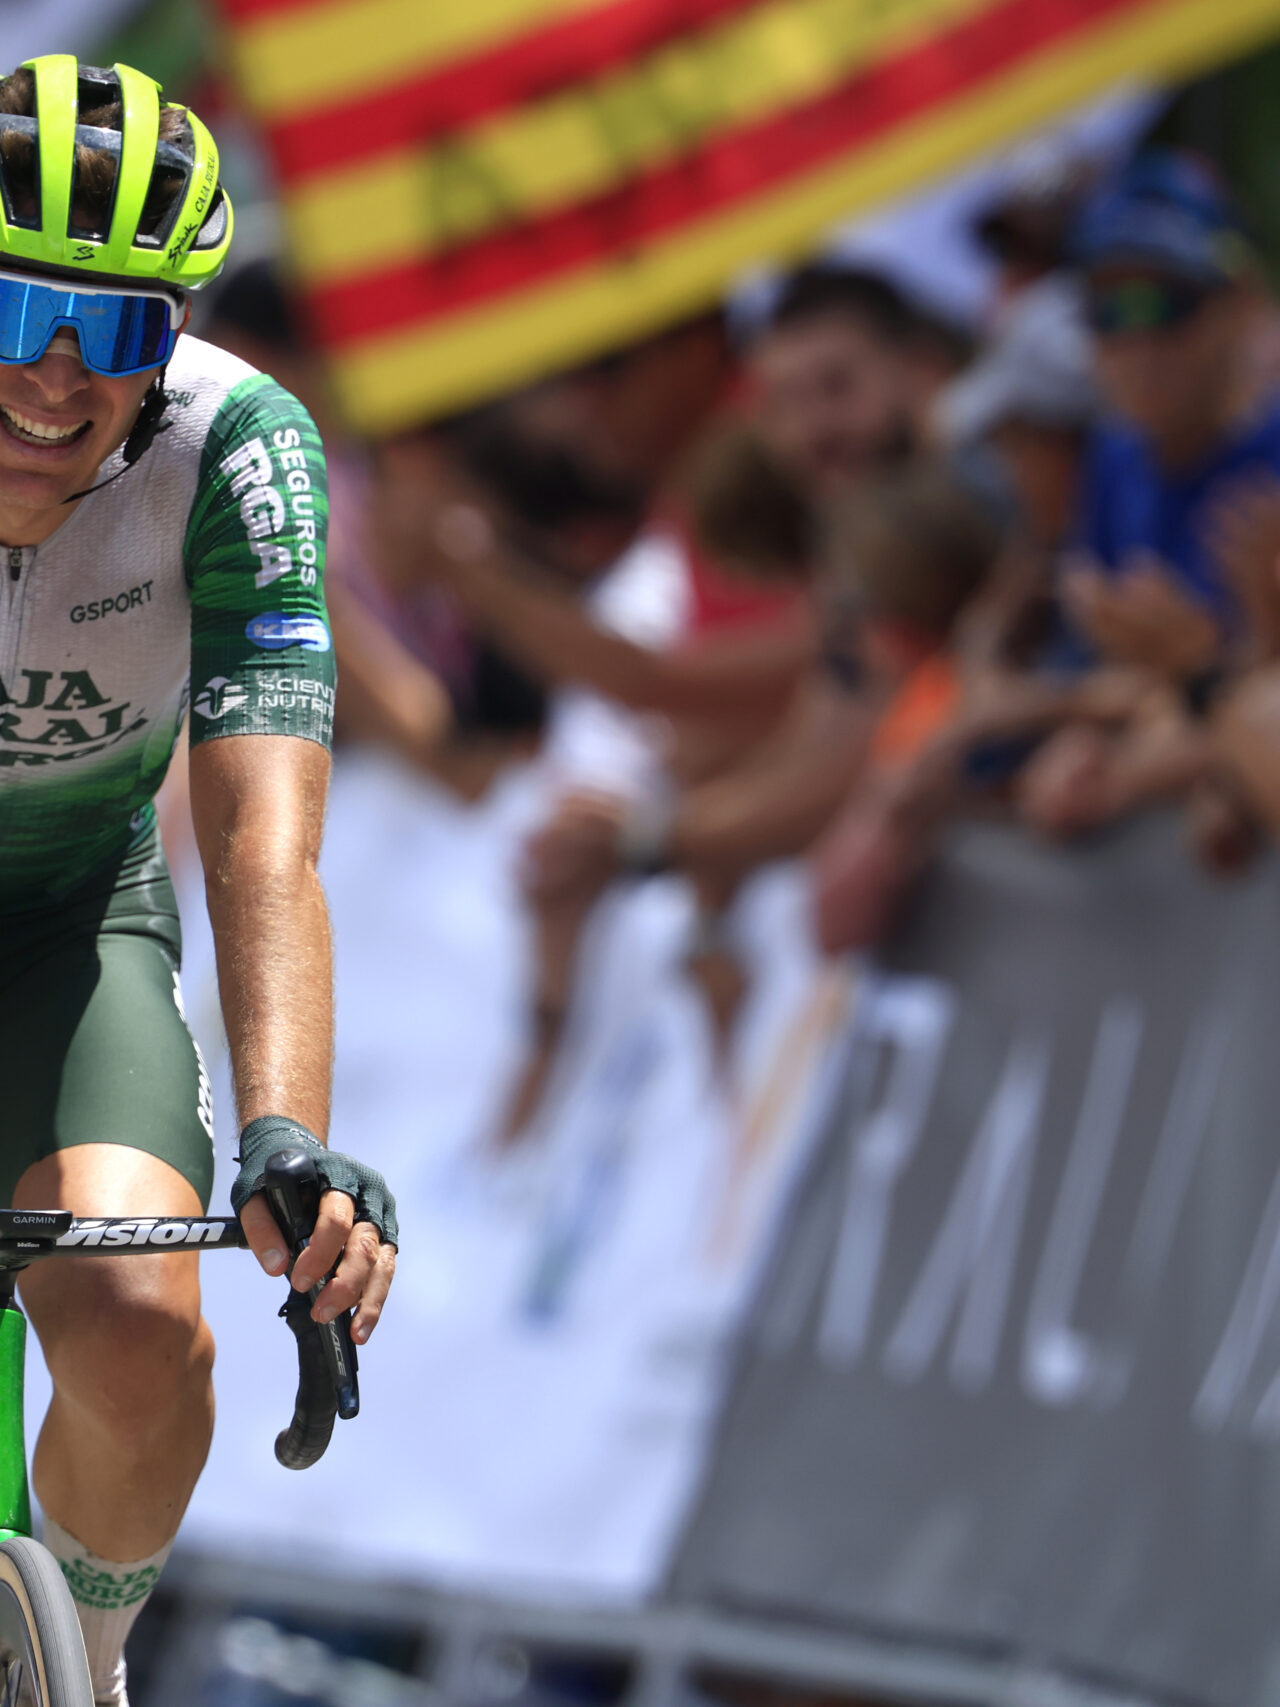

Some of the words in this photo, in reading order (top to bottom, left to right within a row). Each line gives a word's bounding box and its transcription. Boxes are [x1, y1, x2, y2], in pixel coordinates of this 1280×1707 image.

[219, 436, 294, 590] RGA
[273, 427, 318, 588] SEGUROS
[70, 579, 154, 624] GSPORT
[12, 1216, 56, 1225] GARMIN
